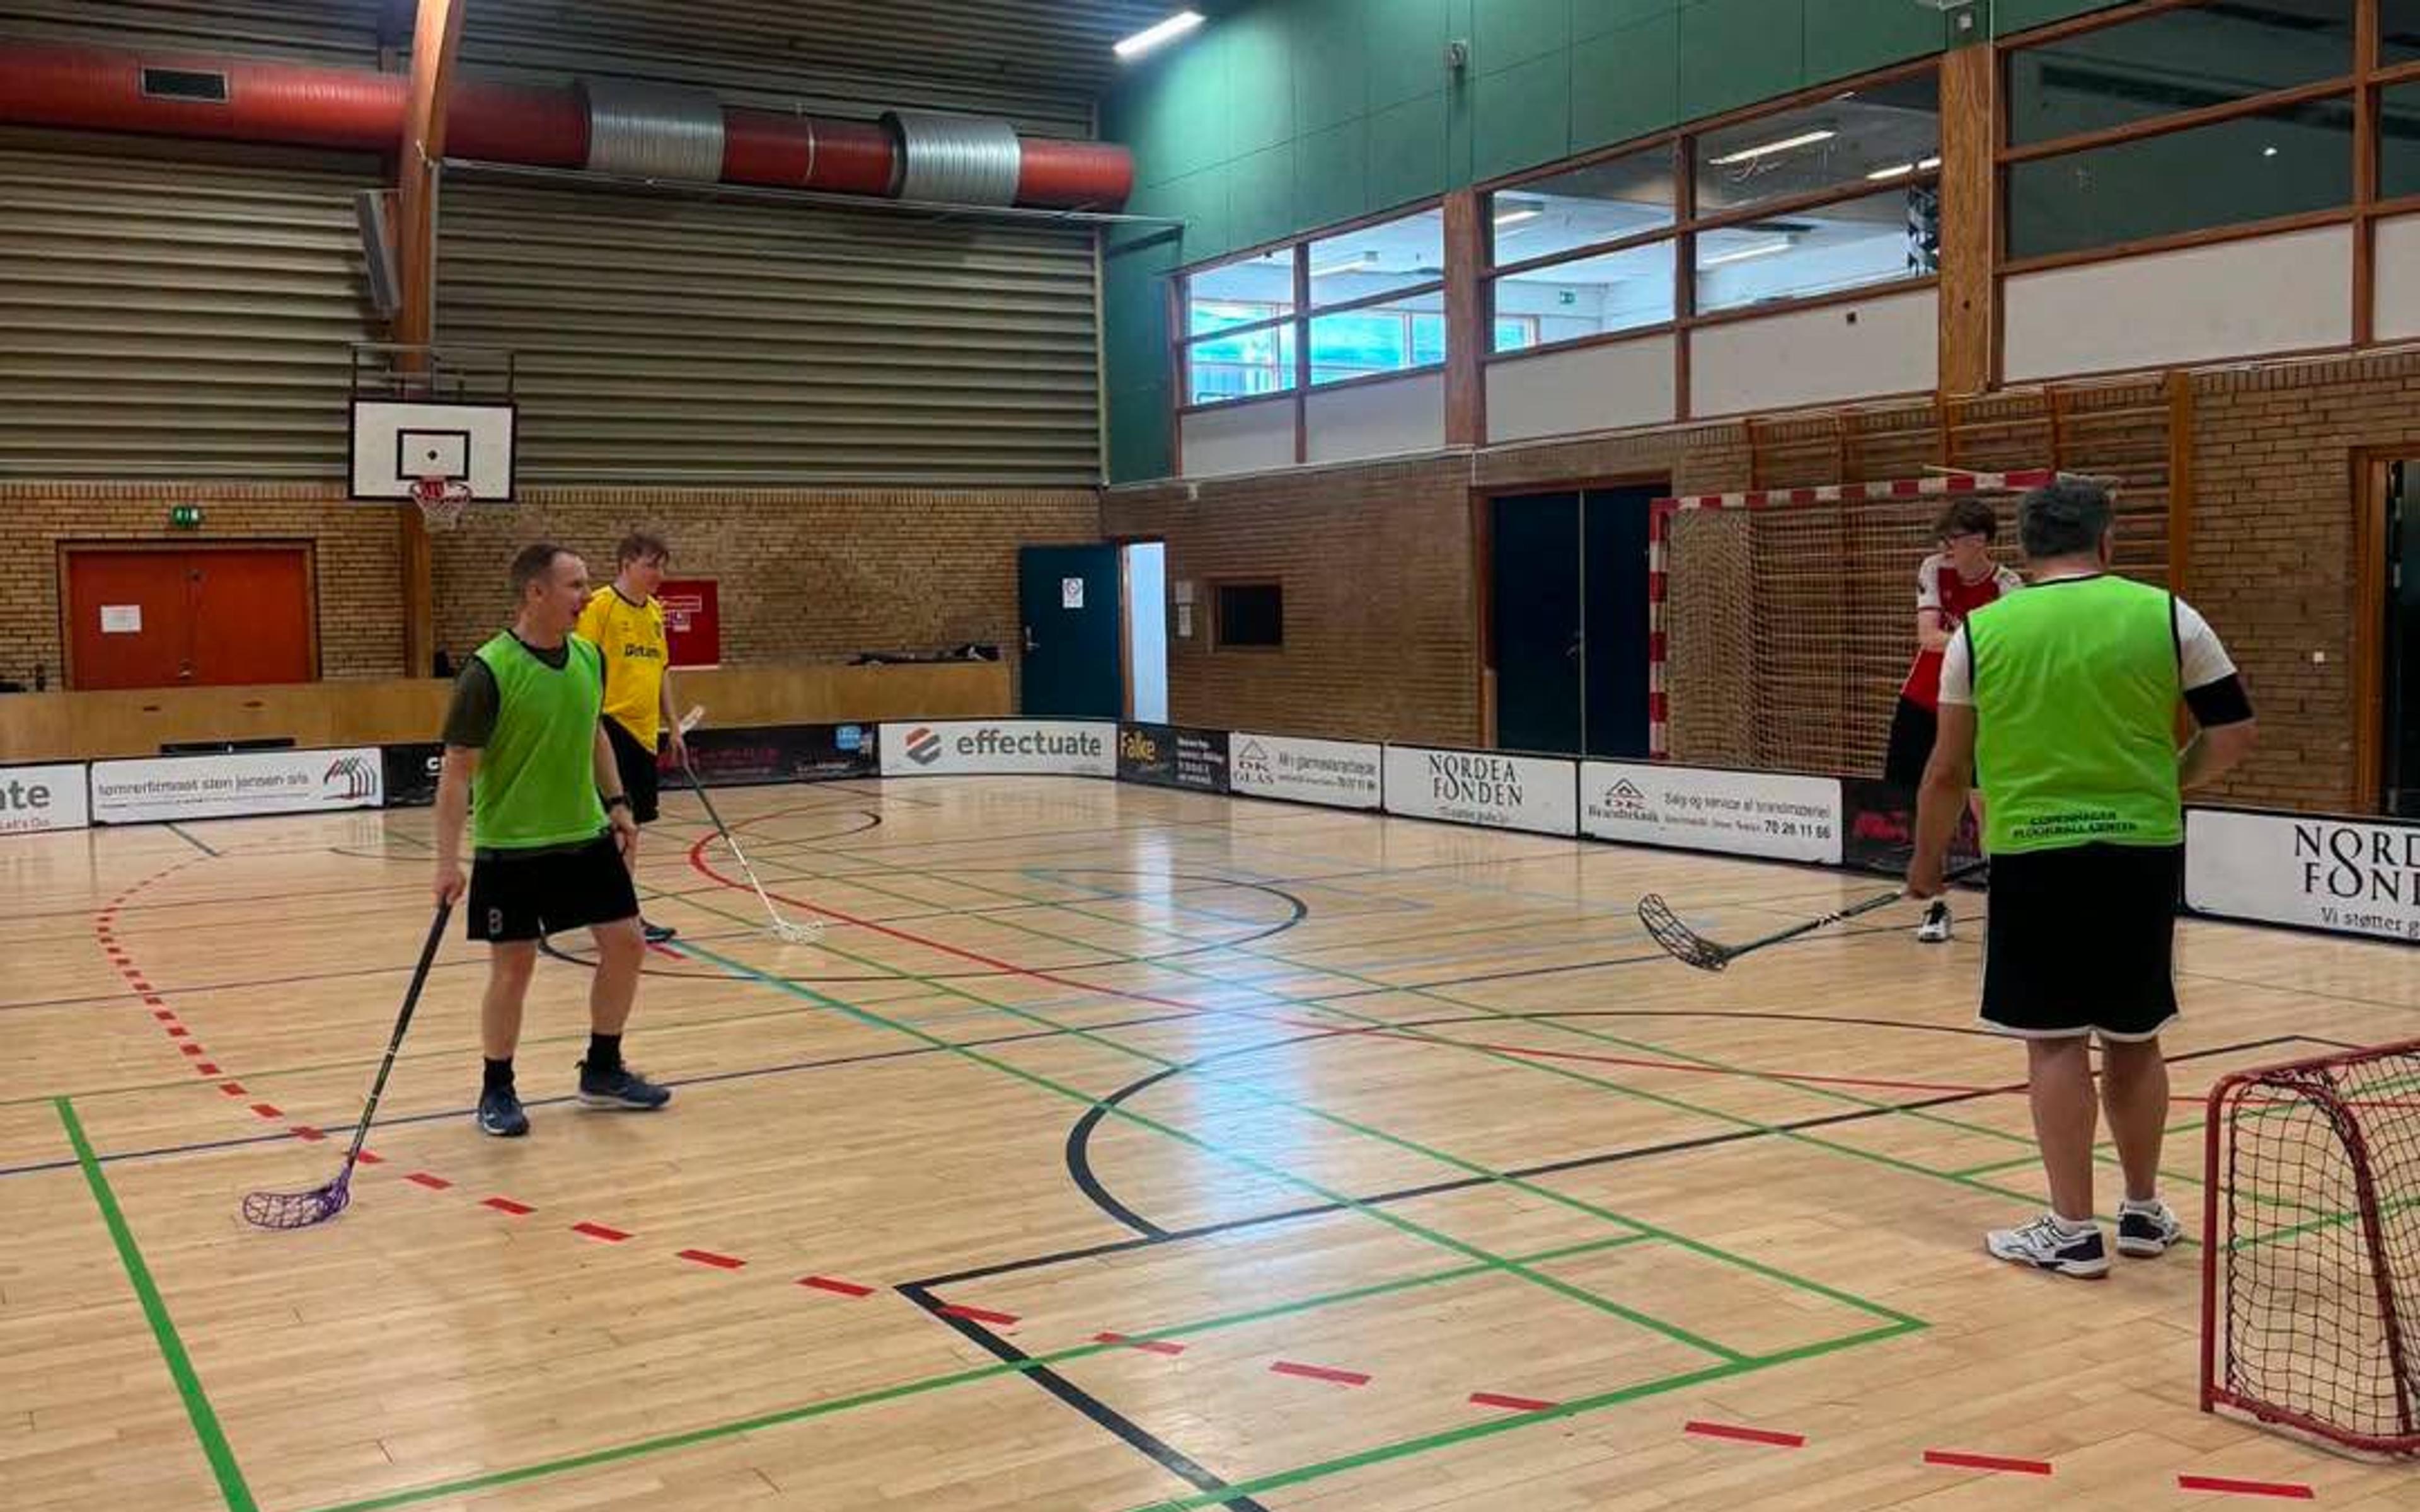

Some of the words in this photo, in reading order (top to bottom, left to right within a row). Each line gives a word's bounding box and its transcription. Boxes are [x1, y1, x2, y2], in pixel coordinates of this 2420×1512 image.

[956, 729, 1102, 756] effectuate
[1429, 754, 1517, 783] NORDEA
[1434, 777, 1523, 806] FONDEN
[2320, 907, 2339, 925] Vi
